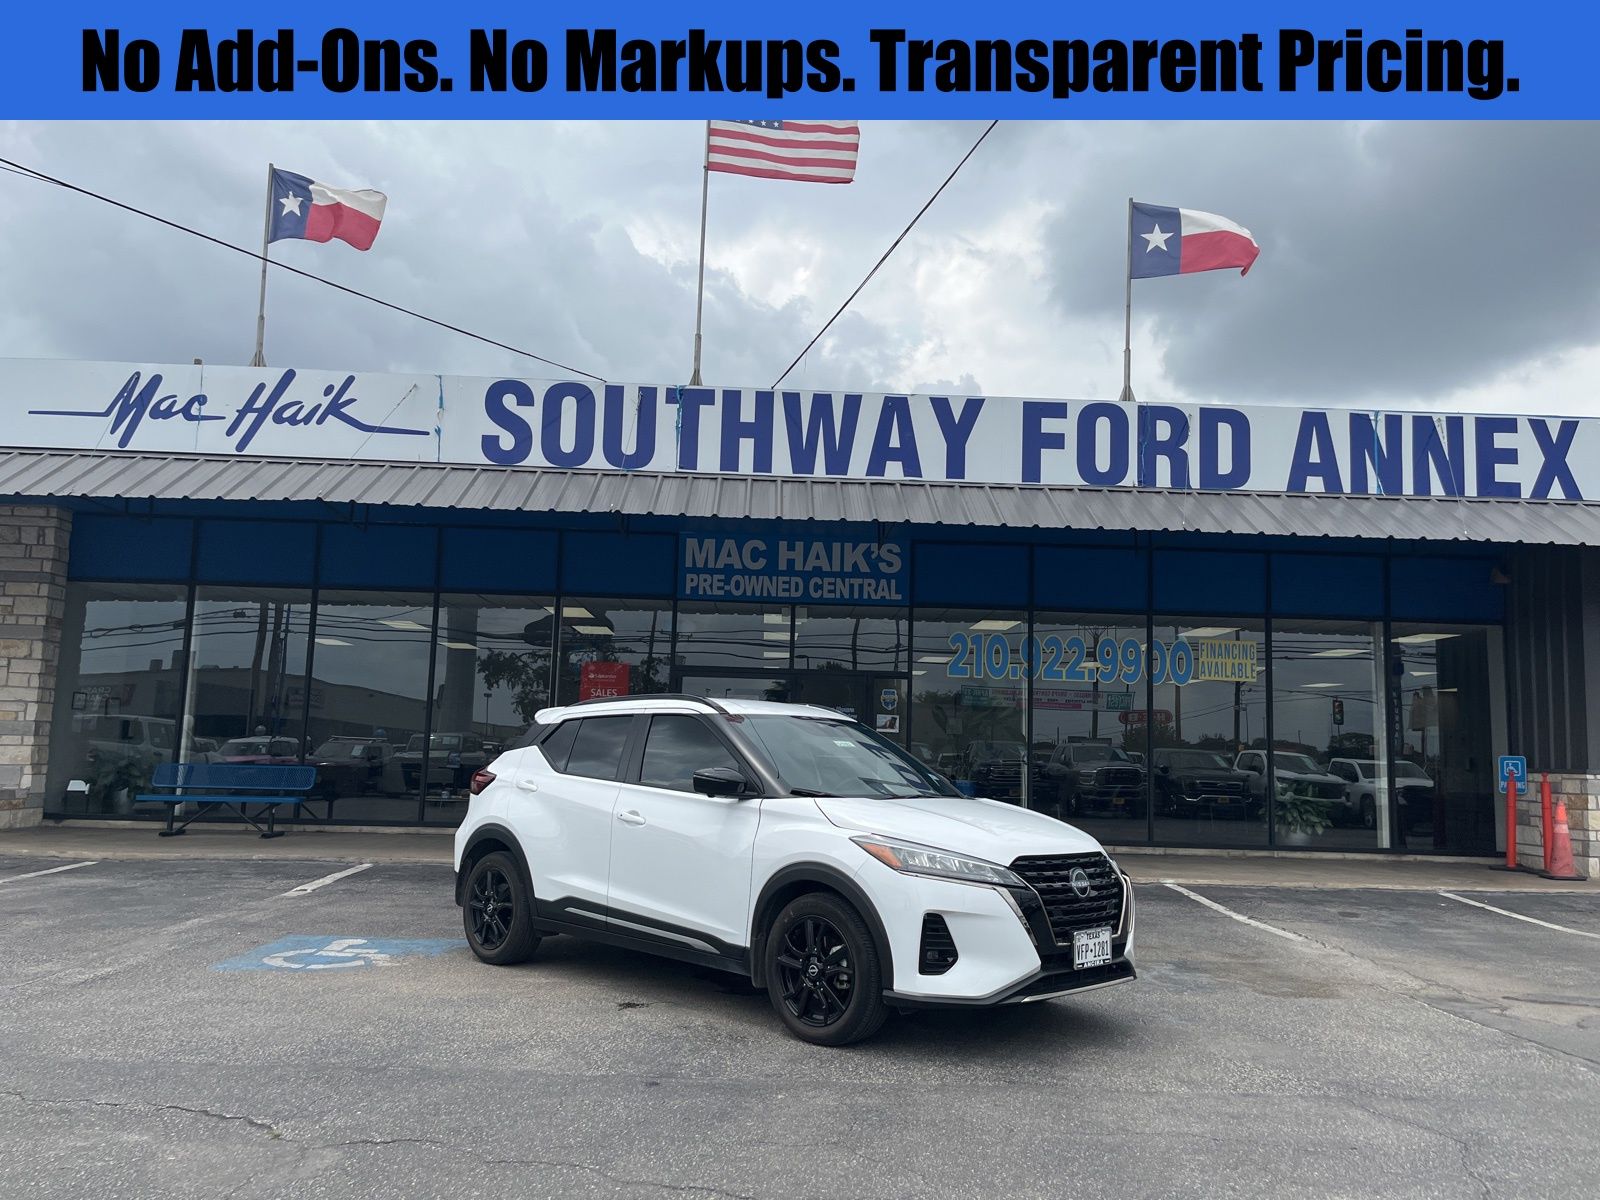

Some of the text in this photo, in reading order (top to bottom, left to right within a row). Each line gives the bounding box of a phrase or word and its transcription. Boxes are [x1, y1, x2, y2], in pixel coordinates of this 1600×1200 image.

[28, 368, 430, 452] Mac Haik
[481, 379, 1584, 501] SOUTHWAY FORD ANNEX
[685, 538, 902, 573] MAC HAIK'S
[685, 573, 902, 600] PRE-OWNED CENTRAL
[947, 632, 1194, 686] 210.922.9900
[1199, 640, 1256, 660] FINANCING
[1199, 661, 1257, 680] AVAILABLE
[590, 688, 618, 697] SALES
[1086, 931, 1101, 940] TEXAS
